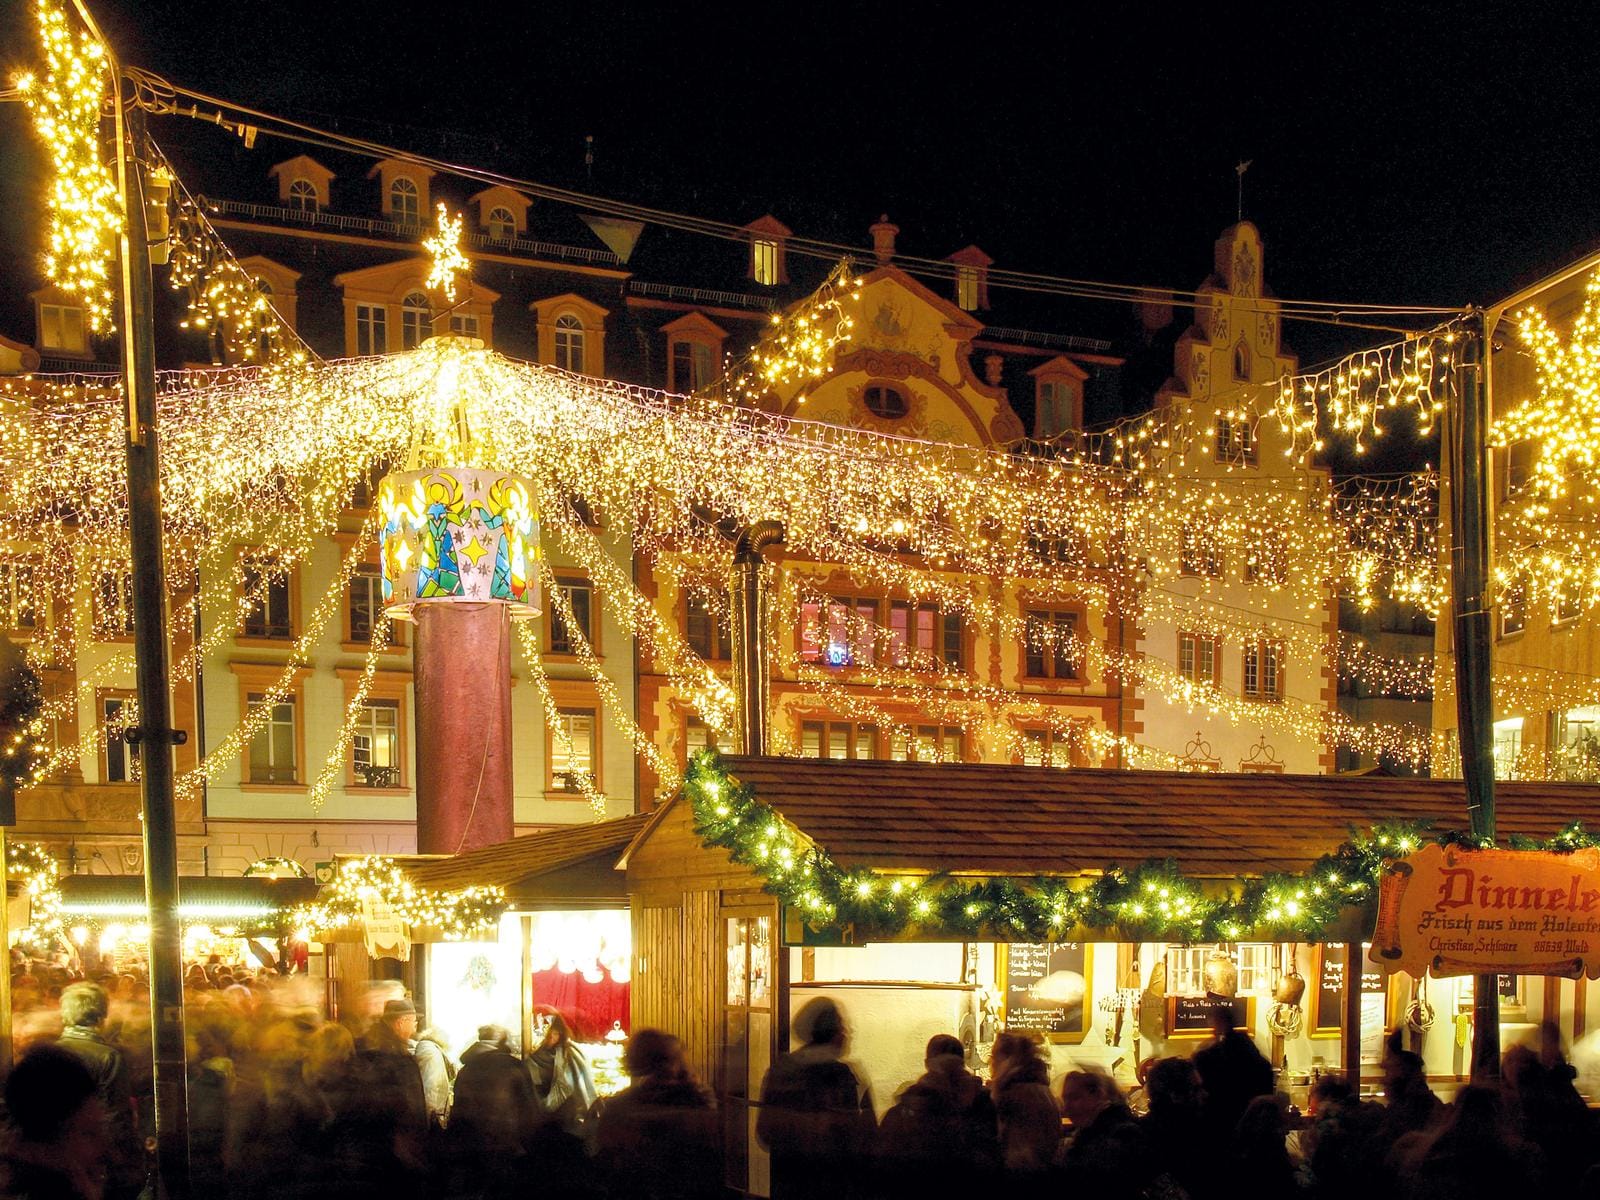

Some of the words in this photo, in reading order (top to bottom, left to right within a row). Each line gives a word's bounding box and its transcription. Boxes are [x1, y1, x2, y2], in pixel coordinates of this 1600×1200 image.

[1417, 911, 1473, 935] Frisch
[1477, 919, 1504, 931] aus
[1509, 916, 1537, 931] dem
[1429, 936, 1474, 953] Christian
